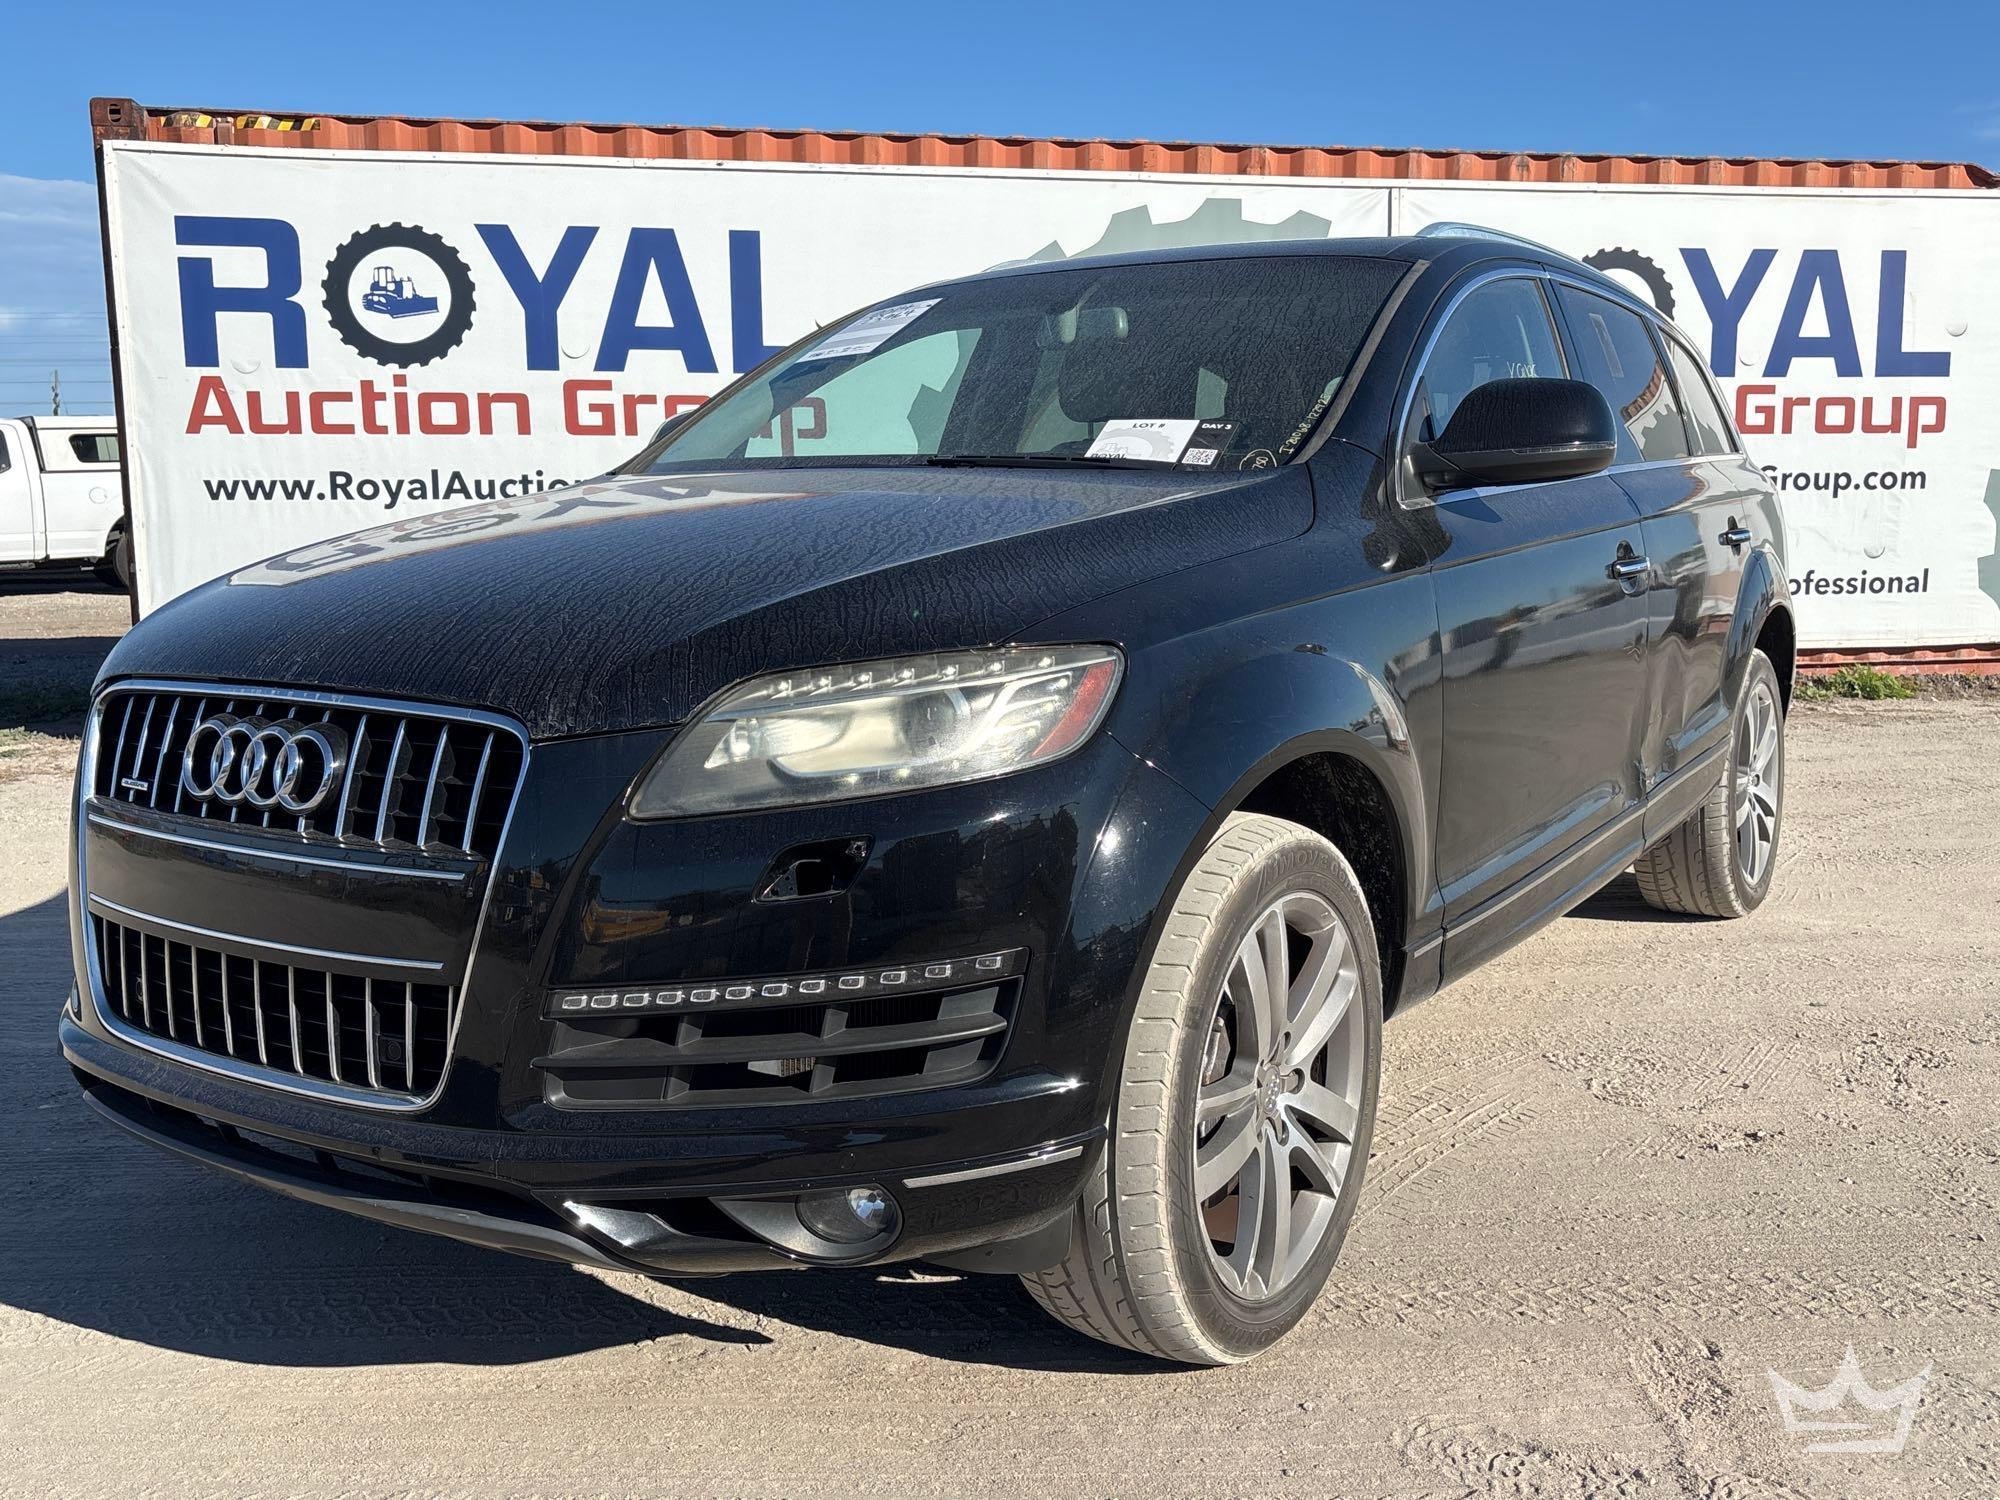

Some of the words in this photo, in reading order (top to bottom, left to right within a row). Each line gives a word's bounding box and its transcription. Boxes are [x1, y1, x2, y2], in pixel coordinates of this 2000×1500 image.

[174, 215, 790, 373] ROYAL
[185, 373, 531, 436] Auction
[563, 379, 827, 456] Grp
[1201, 422, 1224, 430] DAY
[1735, 384, 1947, 449] Group
[203, 468, 586, 510] www.RoyalAucti
